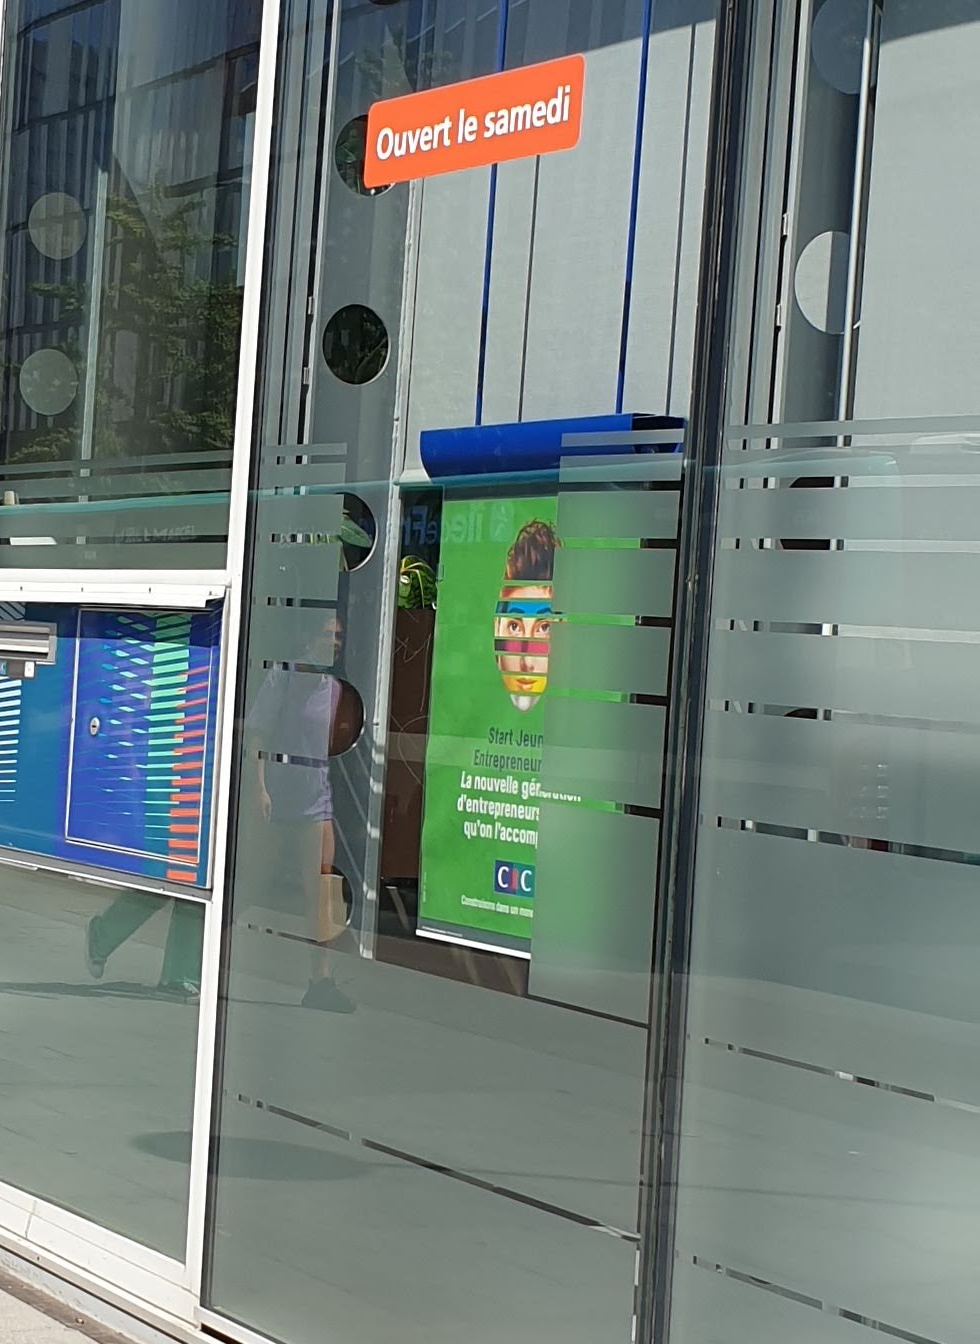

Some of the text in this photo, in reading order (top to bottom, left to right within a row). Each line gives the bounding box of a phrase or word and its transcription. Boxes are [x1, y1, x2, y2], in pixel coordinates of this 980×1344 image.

[376, 84, 571, 161] Ouvert le samedi
[488, 726, 544, 748] Start Jeun
[474, 749, 542, 773] Entrepreneur
[460, 770, 472, 789] La
[474, 774, 519, 795] nouvelle
[464, 819, 538, 849] qu'on l'accom
[497, 865, 532, 892] CIC
